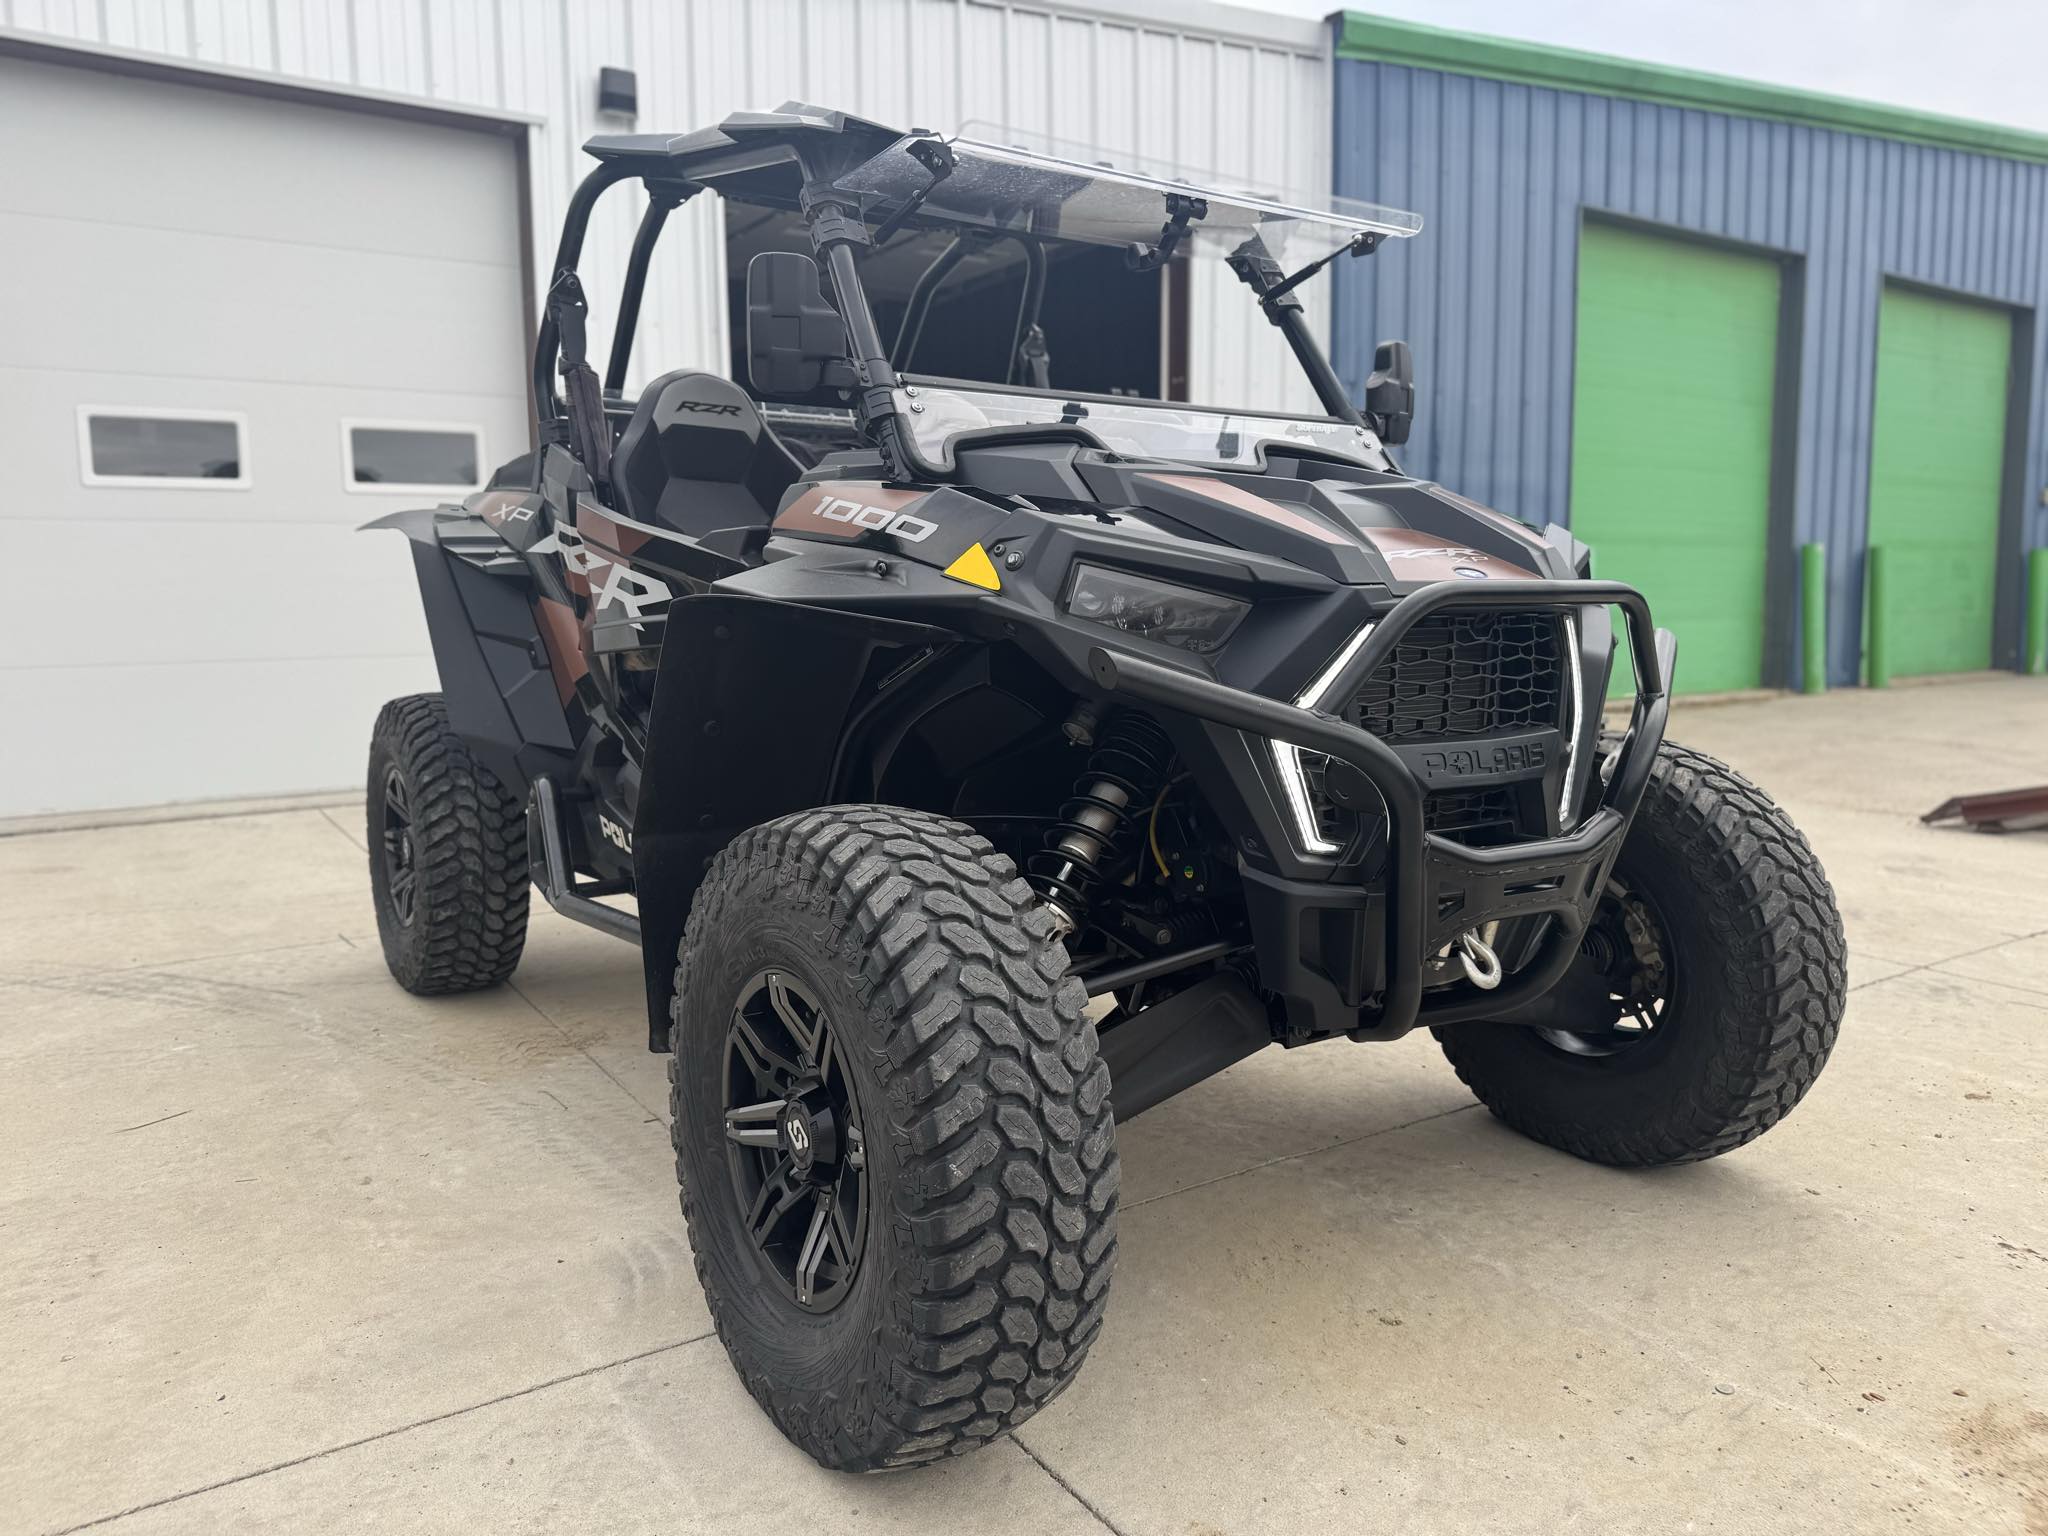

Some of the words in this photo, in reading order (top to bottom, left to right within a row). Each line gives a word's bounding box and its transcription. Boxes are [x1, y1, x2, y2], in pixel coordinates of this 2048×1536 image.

[675, 401, 742, 417] RZR
[491, 503, 535, 521] XP
[812, 496, 939, 542] 1000
[1421, 743, 1546, 778] POLARIS
[598, 813, 633, 854] POL
